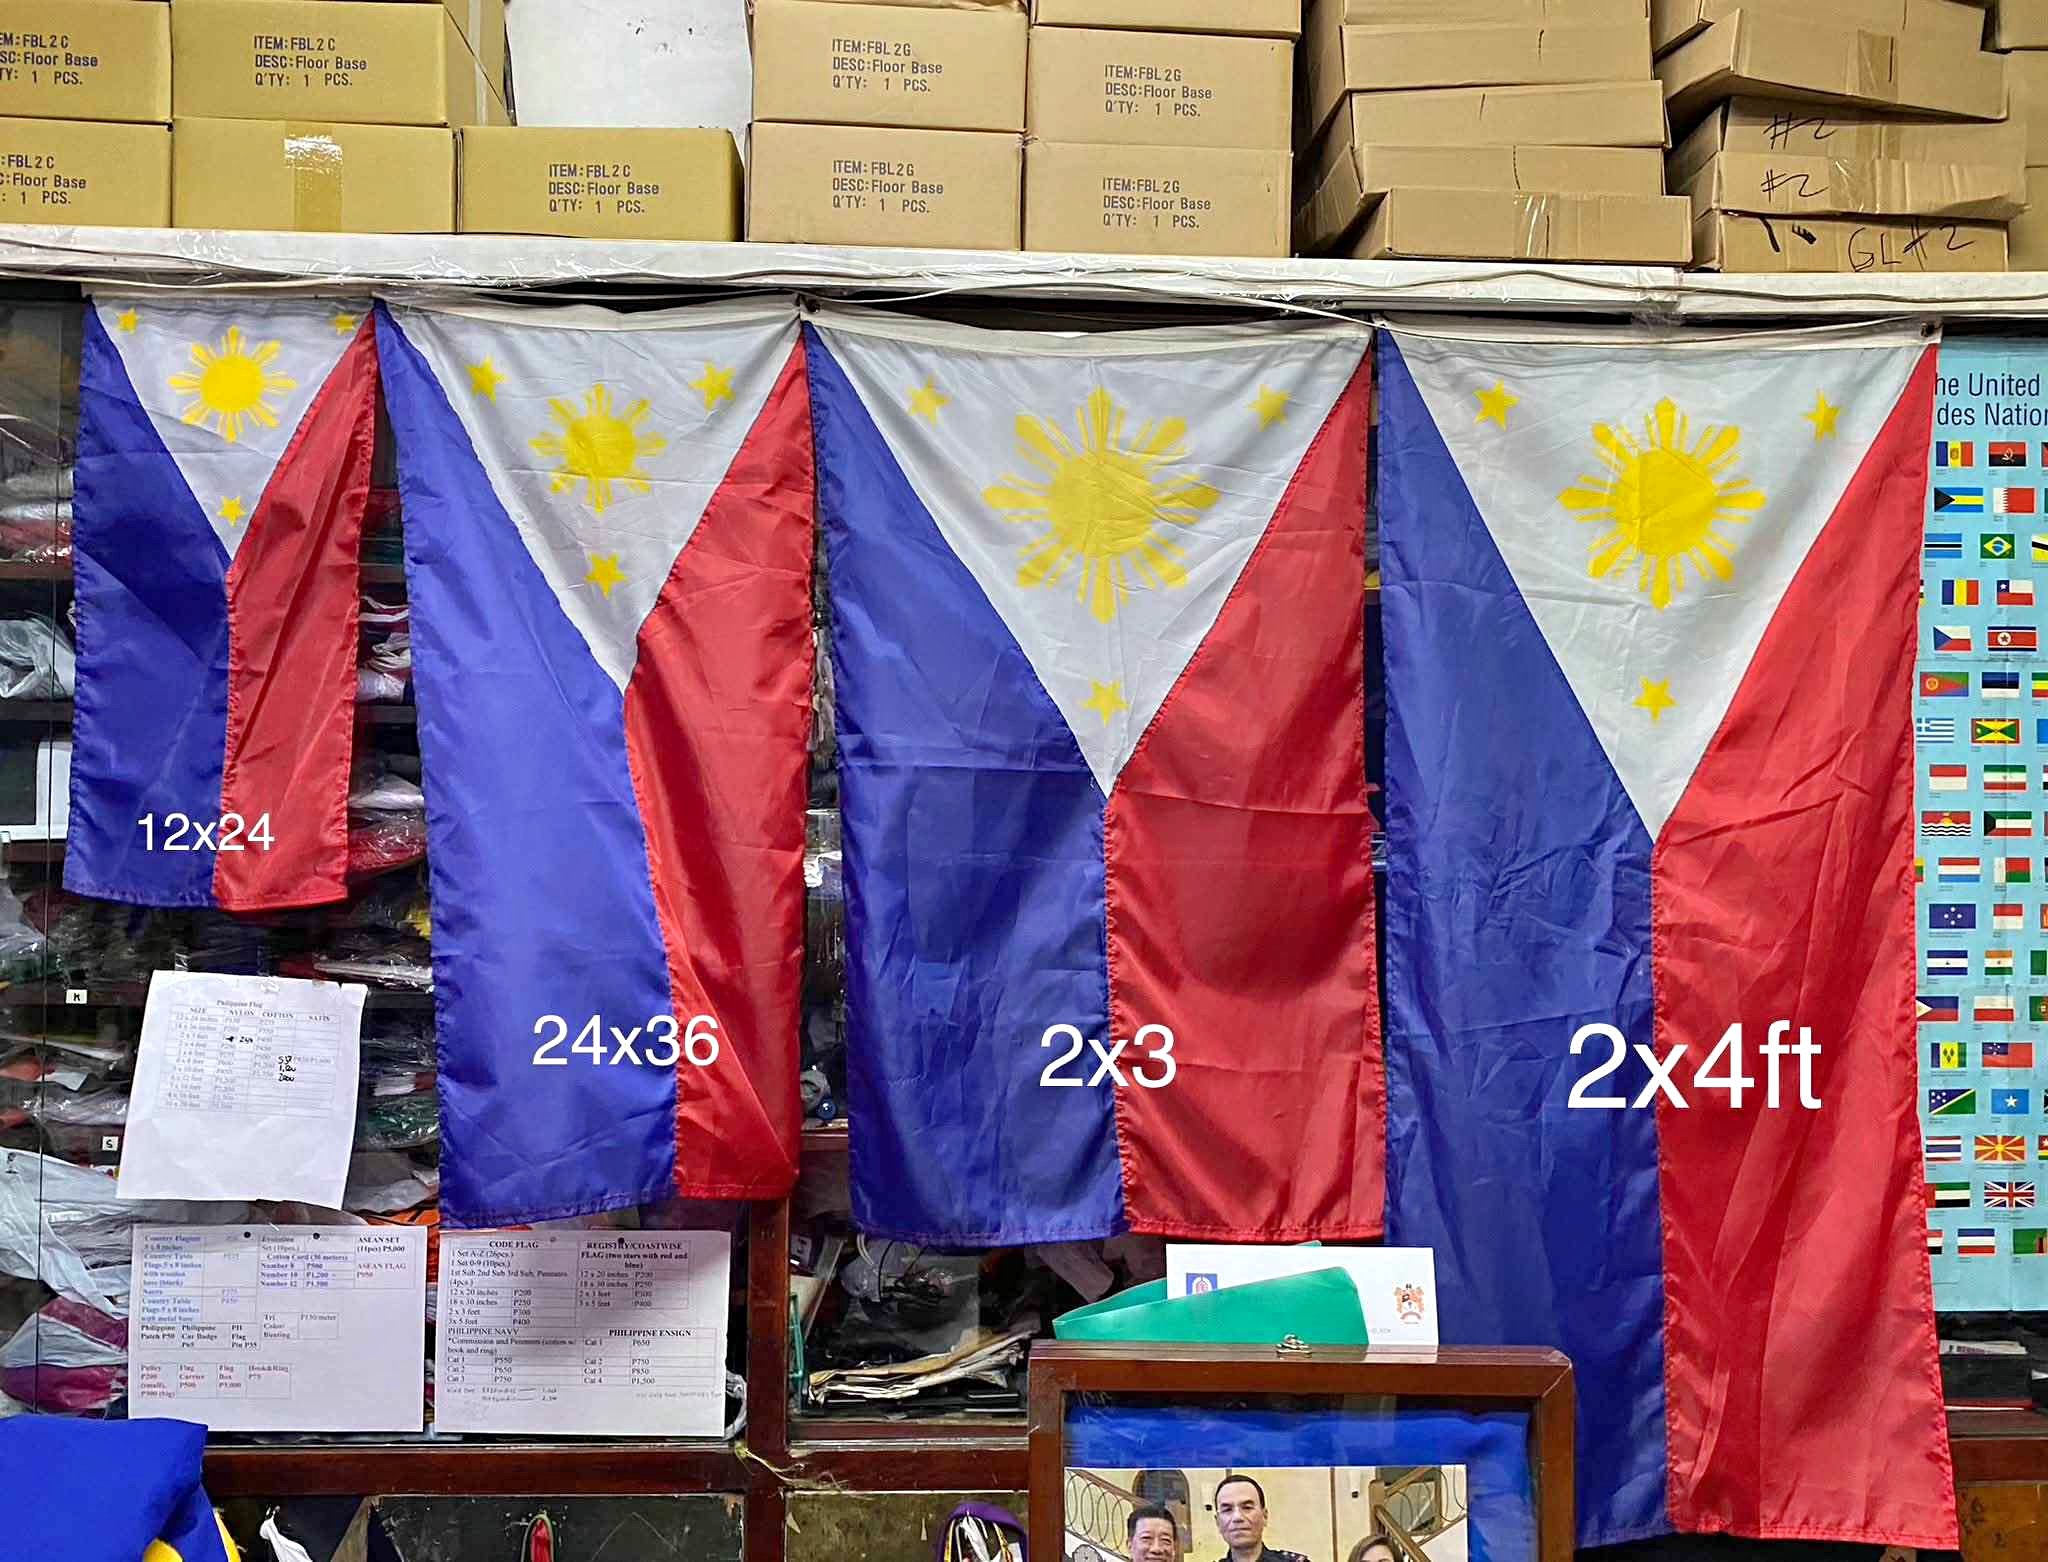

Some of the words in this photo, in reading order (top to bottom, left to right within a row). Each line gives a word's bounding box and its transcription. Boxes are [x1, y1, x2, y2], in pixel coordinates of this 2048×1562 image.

[65, 53, 98, 67] Base
[336, 56, 367, 71] Base
[911, 61, 943, 74] Base
[54, 71, 83, 86] PCS.
[325, 72, 352, 87] PCS.
[904, 78, 931, 92] PCS.
[1182, 86, 1212, 99] Base
[1174, 103, 1200, 117] PCS.
[1763, 112, 1838, 150] #2
[54, 174, 87, 190] Base
[627, 182, 660, 195] Base
[912, 180, 943, 195] Base
[1761, 169, 1828, 204] #2
[42, 190, 71, 205] PCS.
[1181, 197, 1211, 210] Base
[617, 200, 645, 214] PCS.
[902, 199, 930, 213] PCS.
[1173, 215, 1199, 229] PCS.
[1969, 372, 2040, 397] United
[1937, 402, 1975, 426] des
